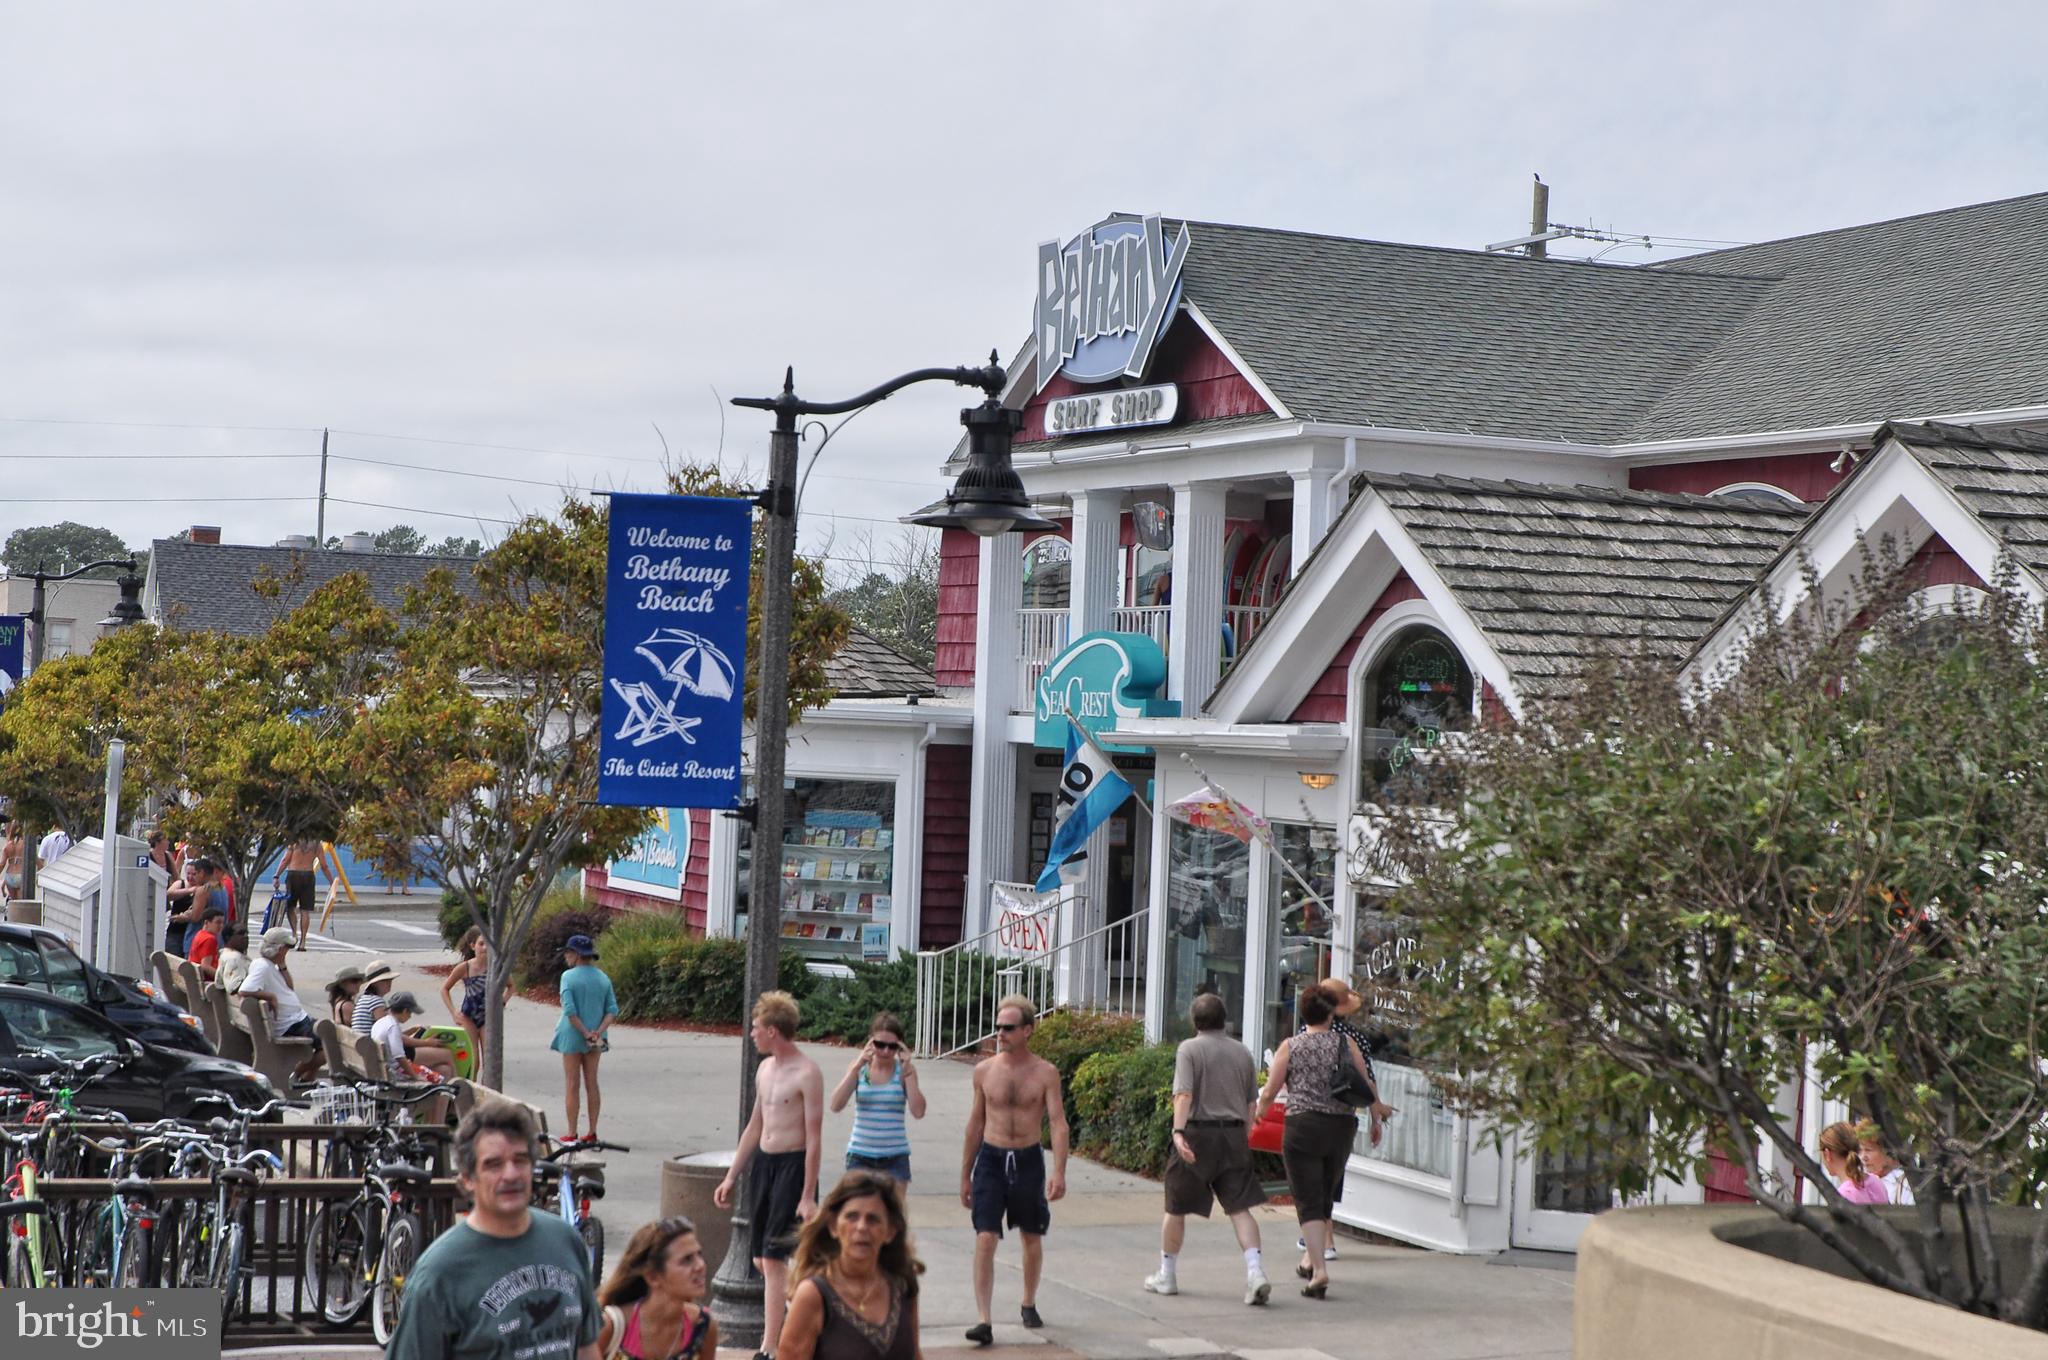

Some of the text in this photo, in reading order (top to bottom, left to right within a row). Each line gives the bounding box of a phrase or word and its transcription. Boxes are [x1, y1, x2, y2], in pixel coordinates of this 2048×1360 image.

[1052, 389, 1163, 431] SURF SHOP
[627, 526, 734, 551] Welcome to
[624, 554, 731, 591] Bethany
[637, 585, 715, 613] Beach
[603, 757, 736, 780] The Quiet Resort
[139, 857, 147, 867] P
[1000, 910, 1049, 953] OPEN
